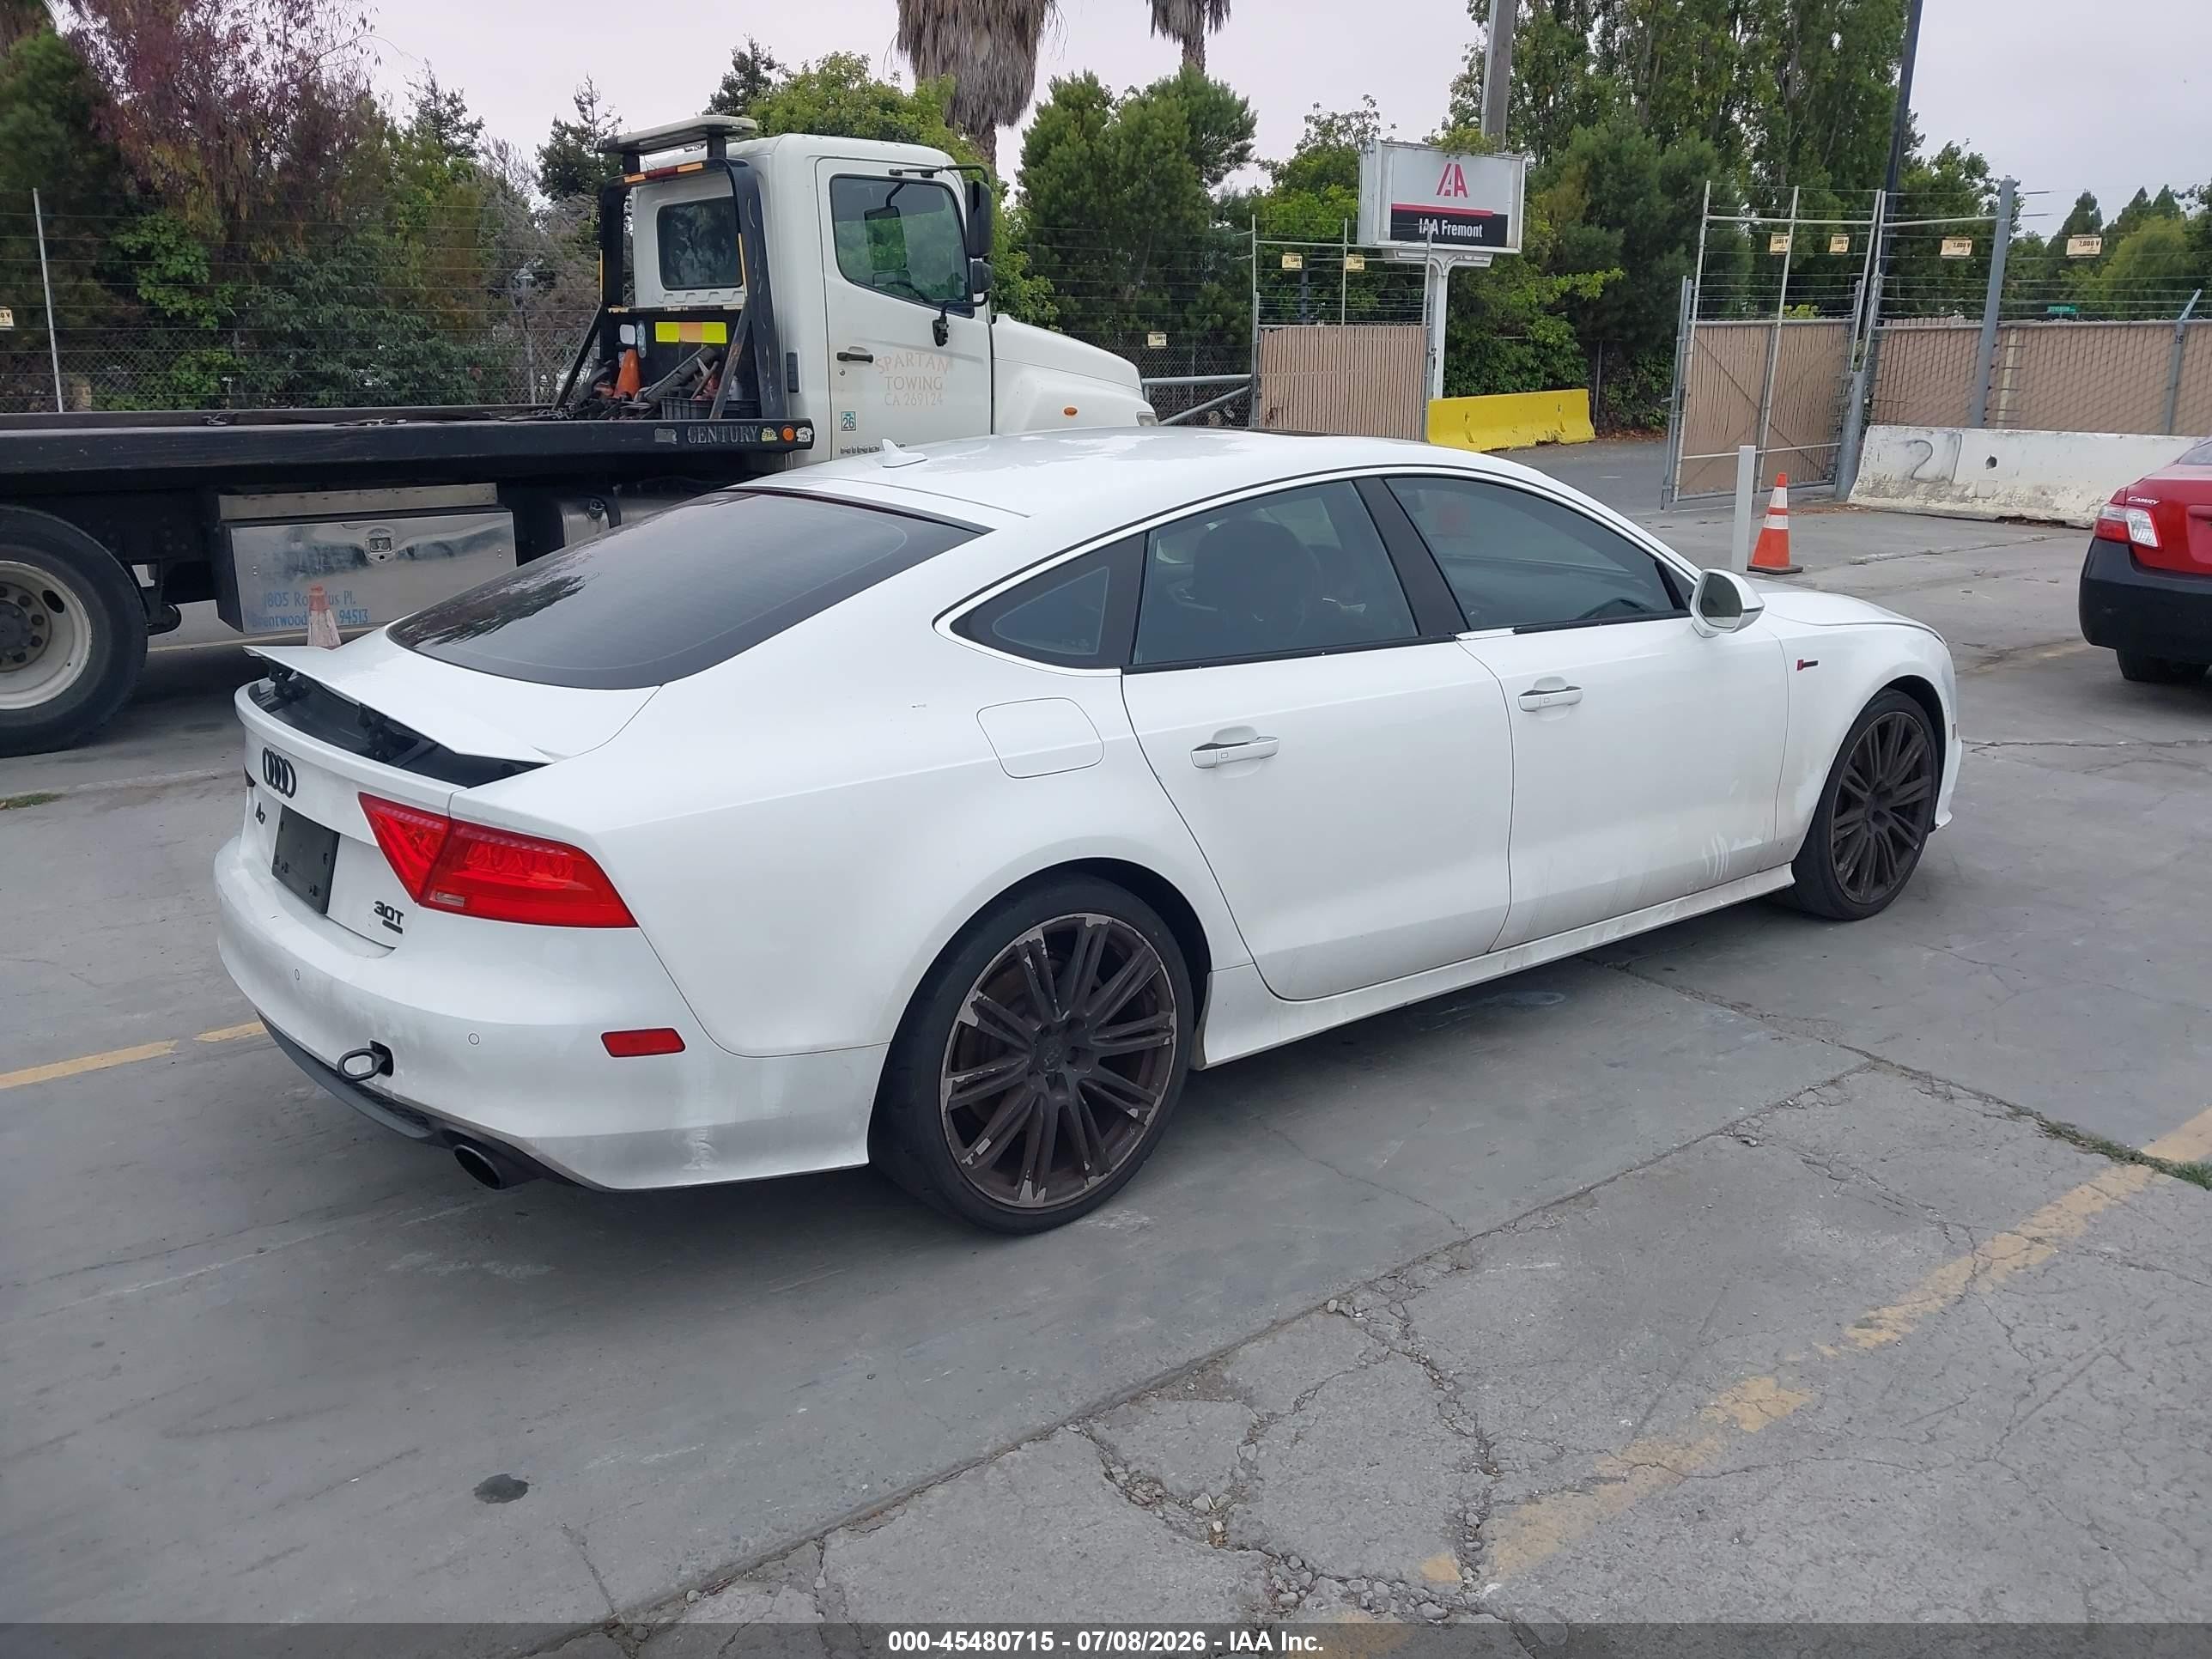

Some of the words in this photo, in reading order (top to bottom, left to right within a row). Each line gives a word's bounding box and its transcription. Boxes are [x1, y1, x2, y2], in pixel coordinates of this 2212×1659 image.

[1441, 219, 1483, 238] Fremont
[874, 352, 949, 374] SPARTAN
[884, 376, 943, 391] TOWING
[884, 393, 900, 405] CA
[904, 392, 943, 405] 269124
[842, 416, 854, 429] 26
[687, 425, 758, 444] CENTURY
[343, 590, 356, 605] Pl.
[339, 608, 368, 625] 94513
